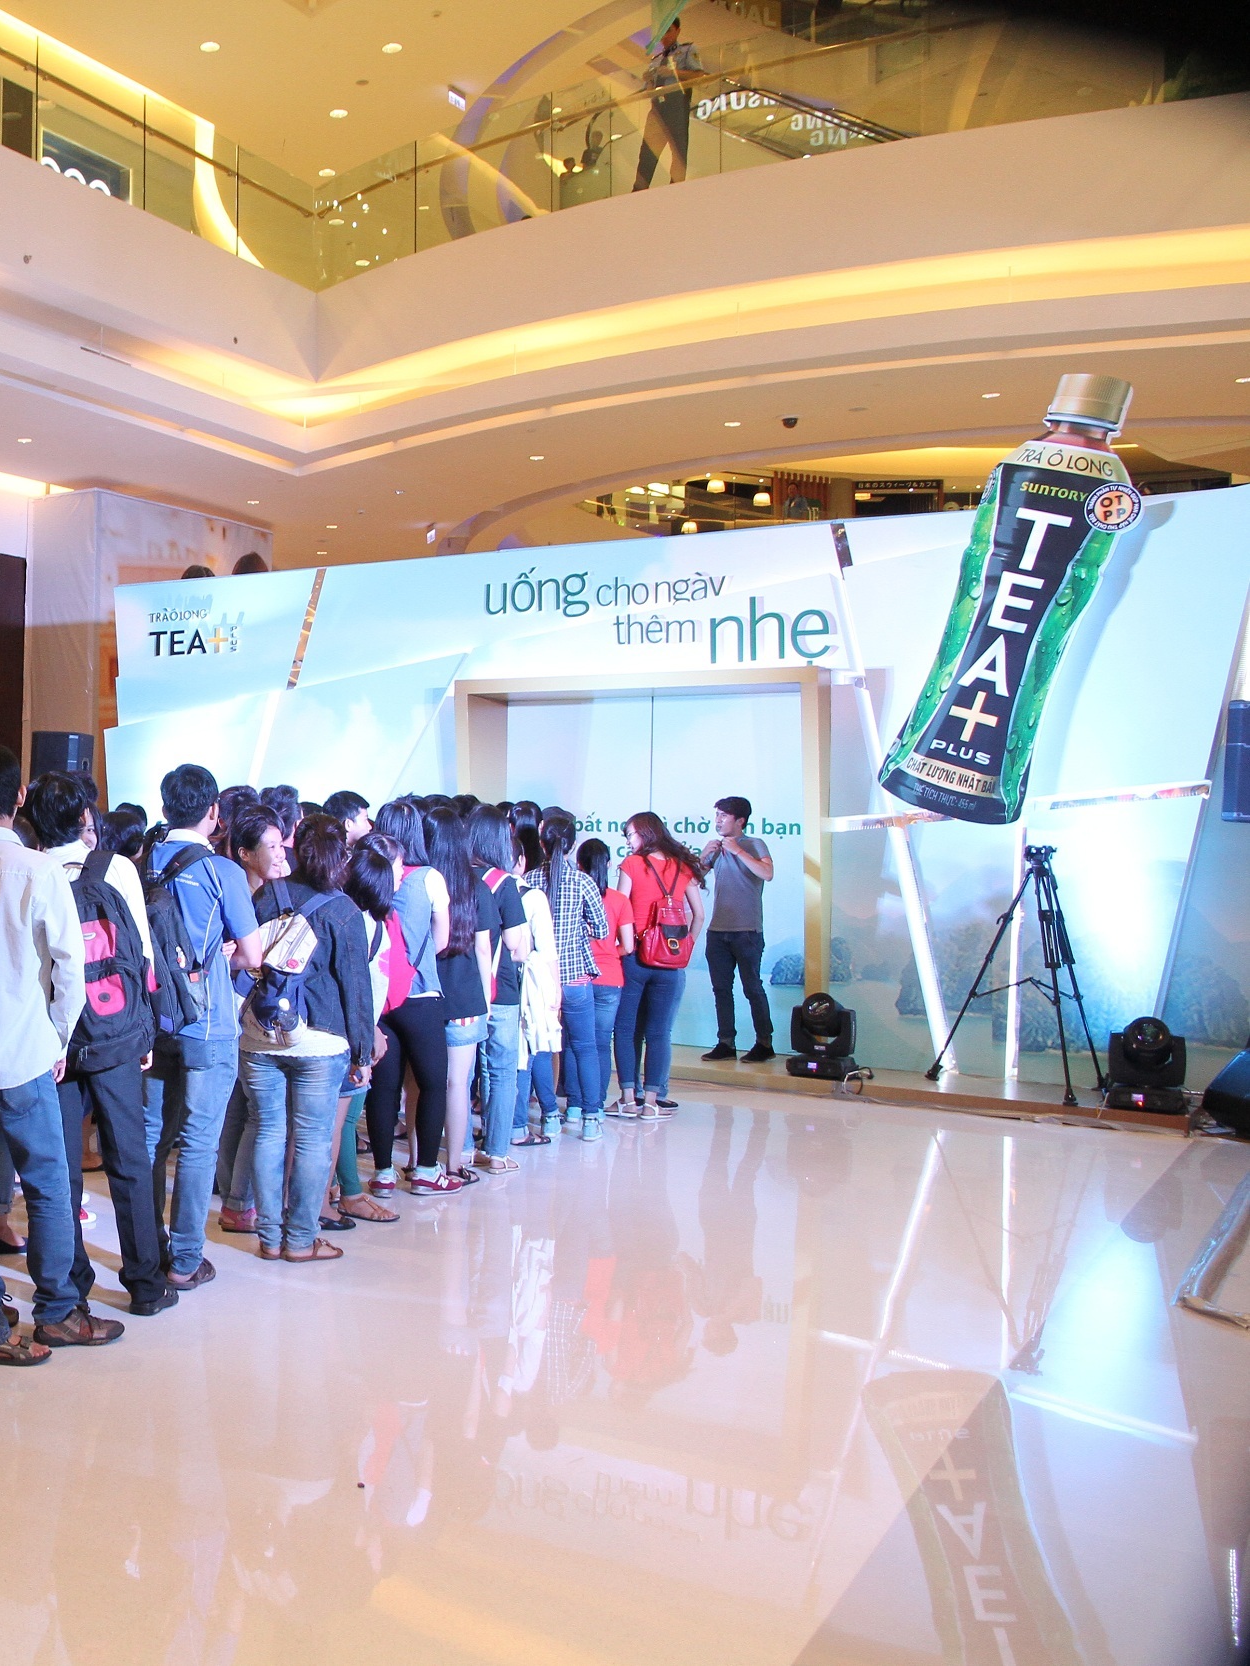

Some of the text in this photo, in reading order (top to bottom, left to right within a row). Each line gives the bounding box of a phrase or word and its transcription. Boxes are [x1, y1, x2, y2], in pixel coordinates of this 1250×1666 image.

[1066, 455, 1113, 477] LONG
[485, 566, 591, 617] uống
[596, 576, 650, 607] cho
[613, 596, 832, 666] thêm nhẹ
[930, 739, 991, 765] PLUS
[906, 757, 927, 774] CHẤT
[926, 764, 955, 784] LƯỢNG
[956, 773, 981, 793] NHẬT
[575, 811, 602, 833] bất
[673, 816, 710, 833] chờ
[762, 817, 801, 839] bạn
